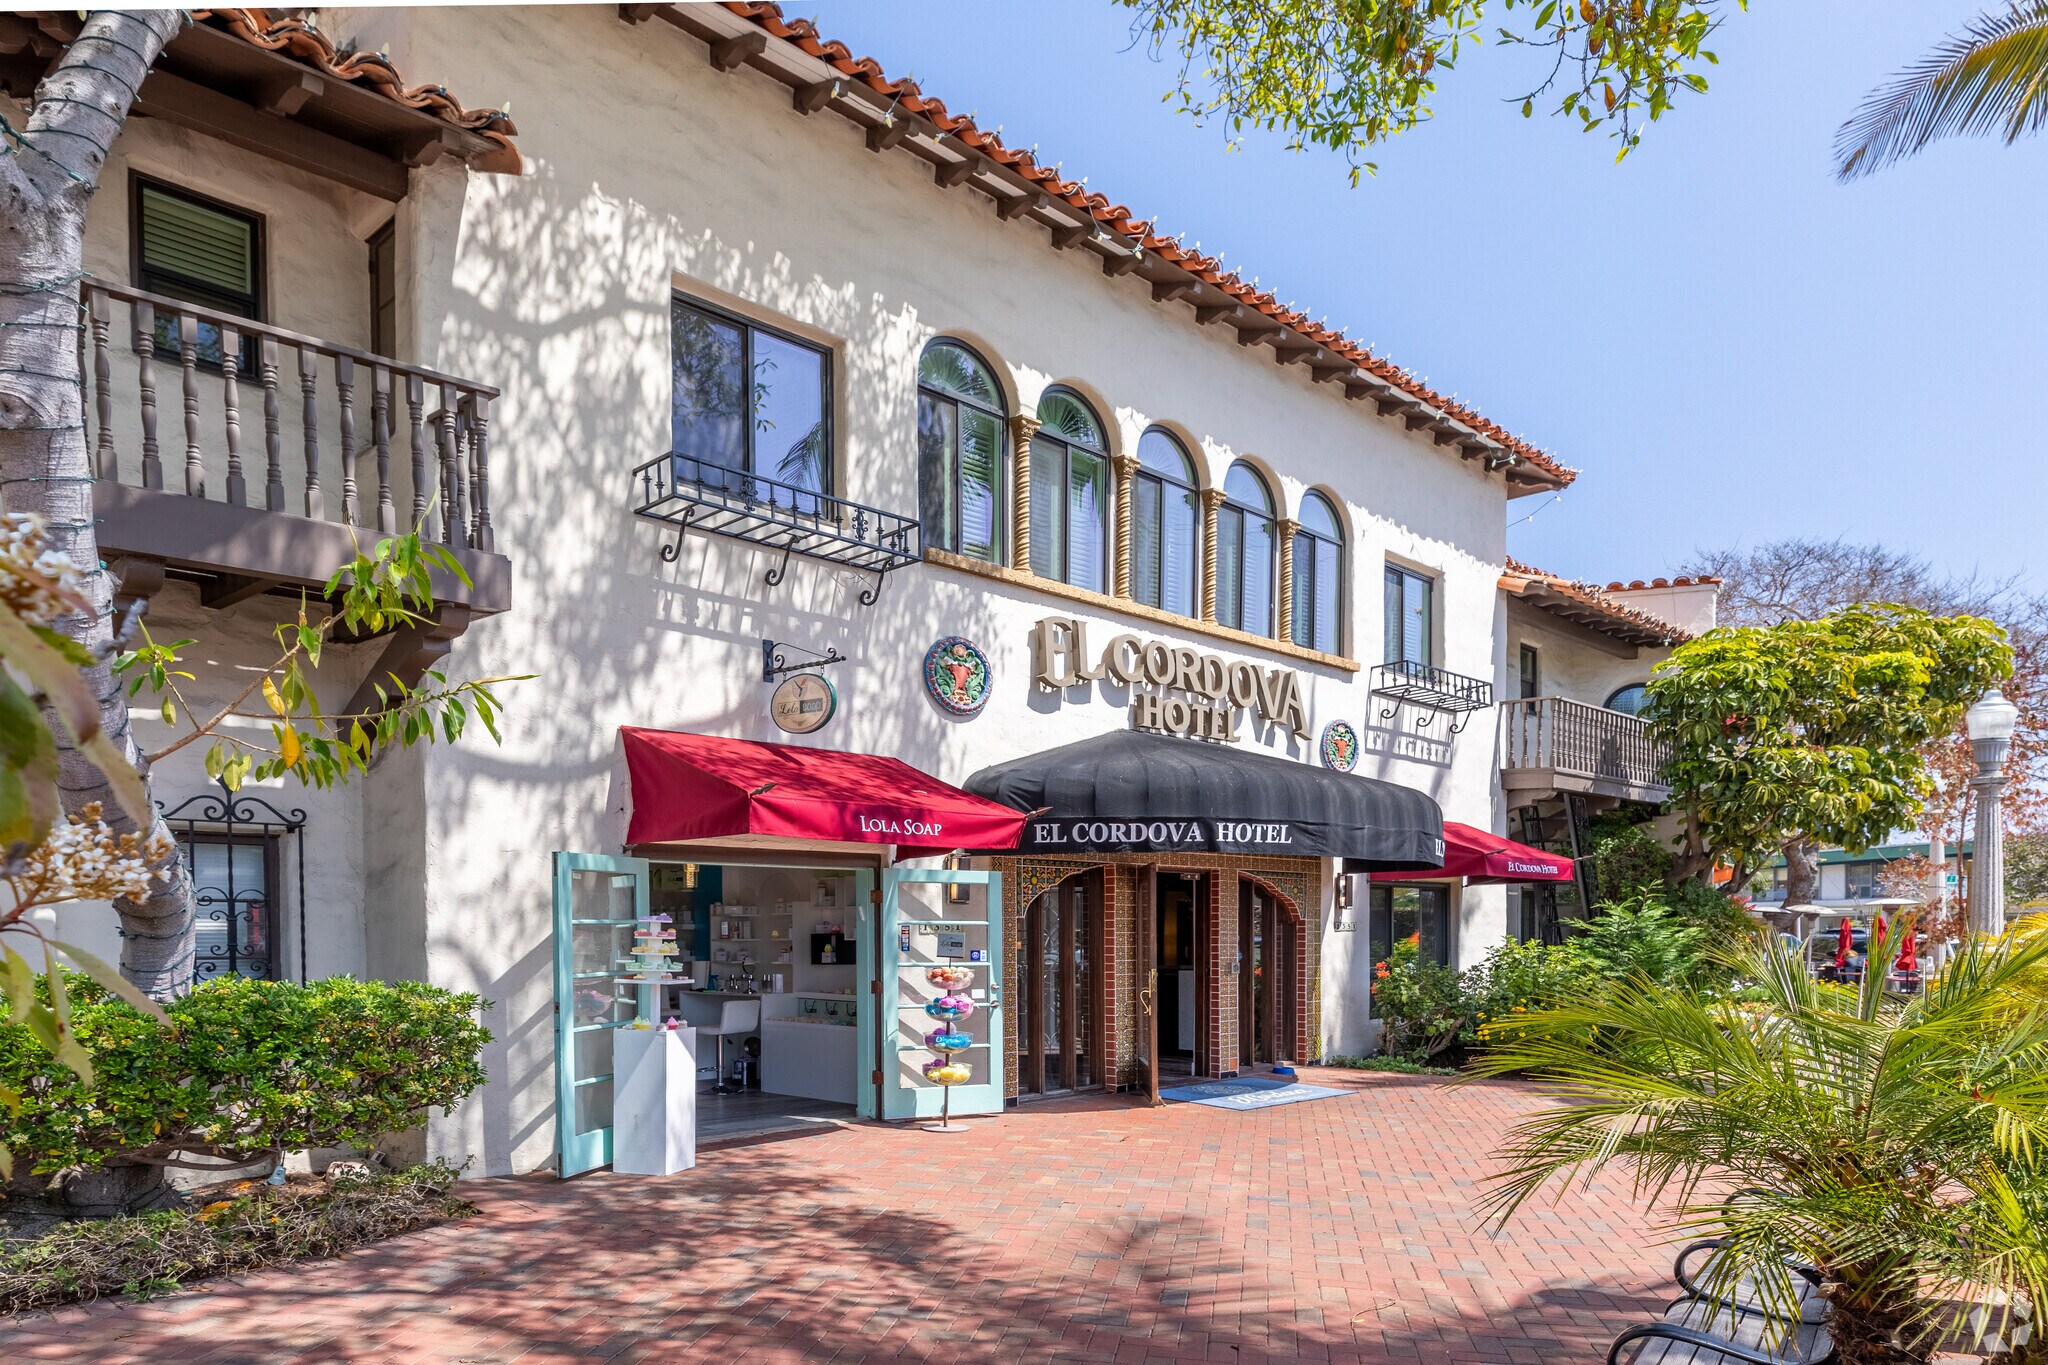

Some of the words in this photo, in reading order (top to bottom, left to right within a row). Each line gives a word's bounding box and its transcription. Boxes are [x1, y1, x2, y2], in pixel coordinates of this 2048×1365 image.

[1034, 616, 1105, 688] EL
[1104, 634, 1312, 741] CORDOVA
[1134, 693, 1241, 742] HOTEL
[860, 815, 901, 833] LOLA
[904, 819, 942, 836] SOAP
[1034, 823, 1067, 843] EL
[1072, 822, 1204, 843] CORDOVA
[1216, 822, 1292, 844] HOTEL
